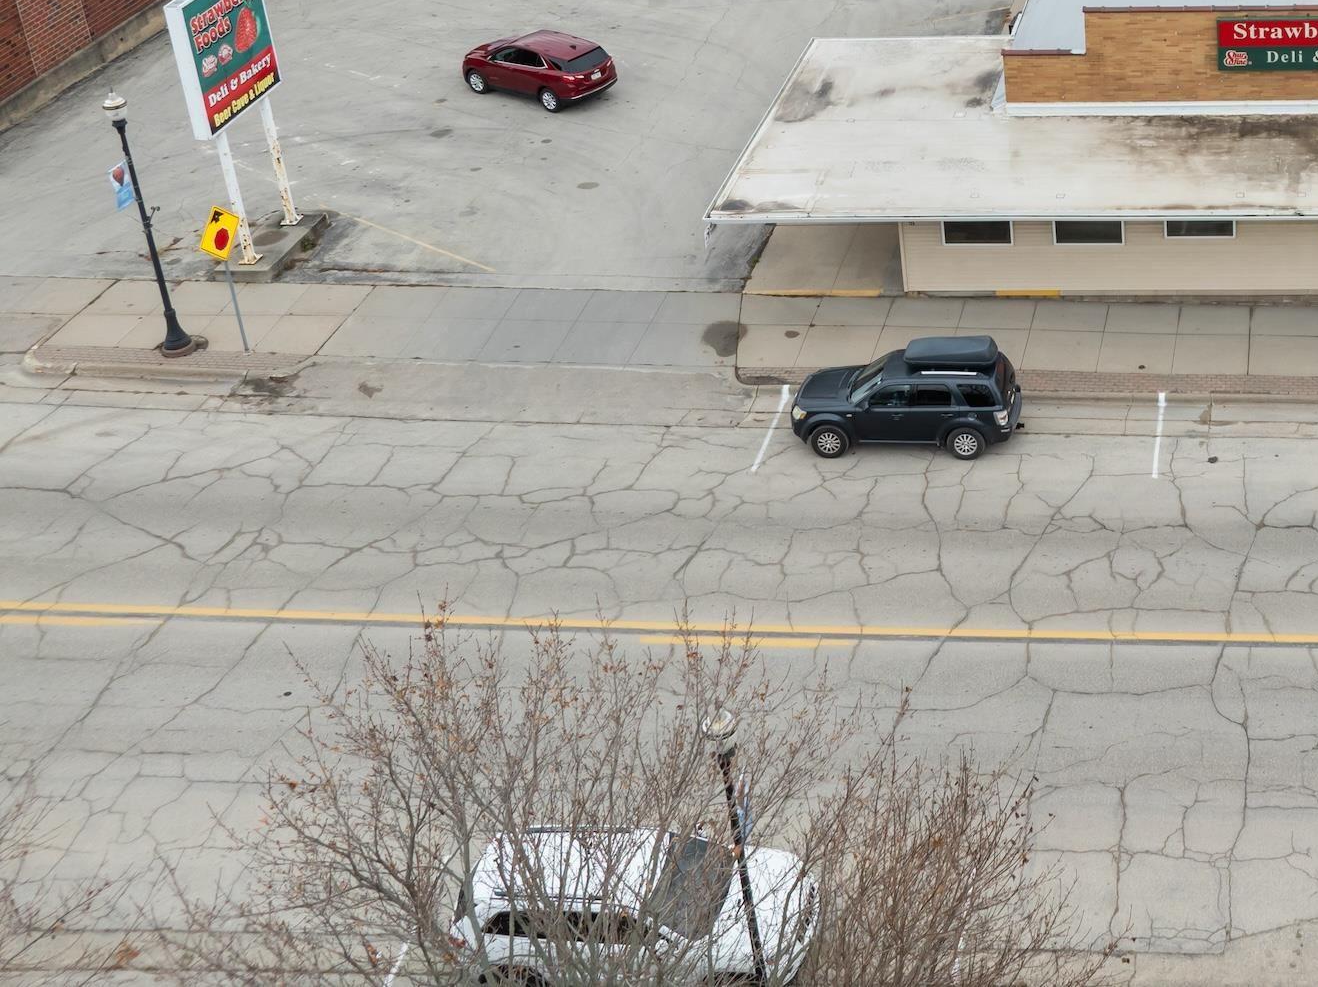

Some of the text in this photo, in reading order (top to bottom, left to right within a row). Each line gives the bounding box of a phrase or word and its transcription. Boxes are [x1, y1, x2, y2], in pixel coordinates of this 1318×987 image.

[193, 16, 231, 54] Foods
[1266, 50, 1303, 63] Deli
[208, 83, 230, 107] Deli
[230, 77, 238, 90] &
[239, 53, 271, 85] Bakery
[213, 72, 275, 128] Beer Cave & Liquor
